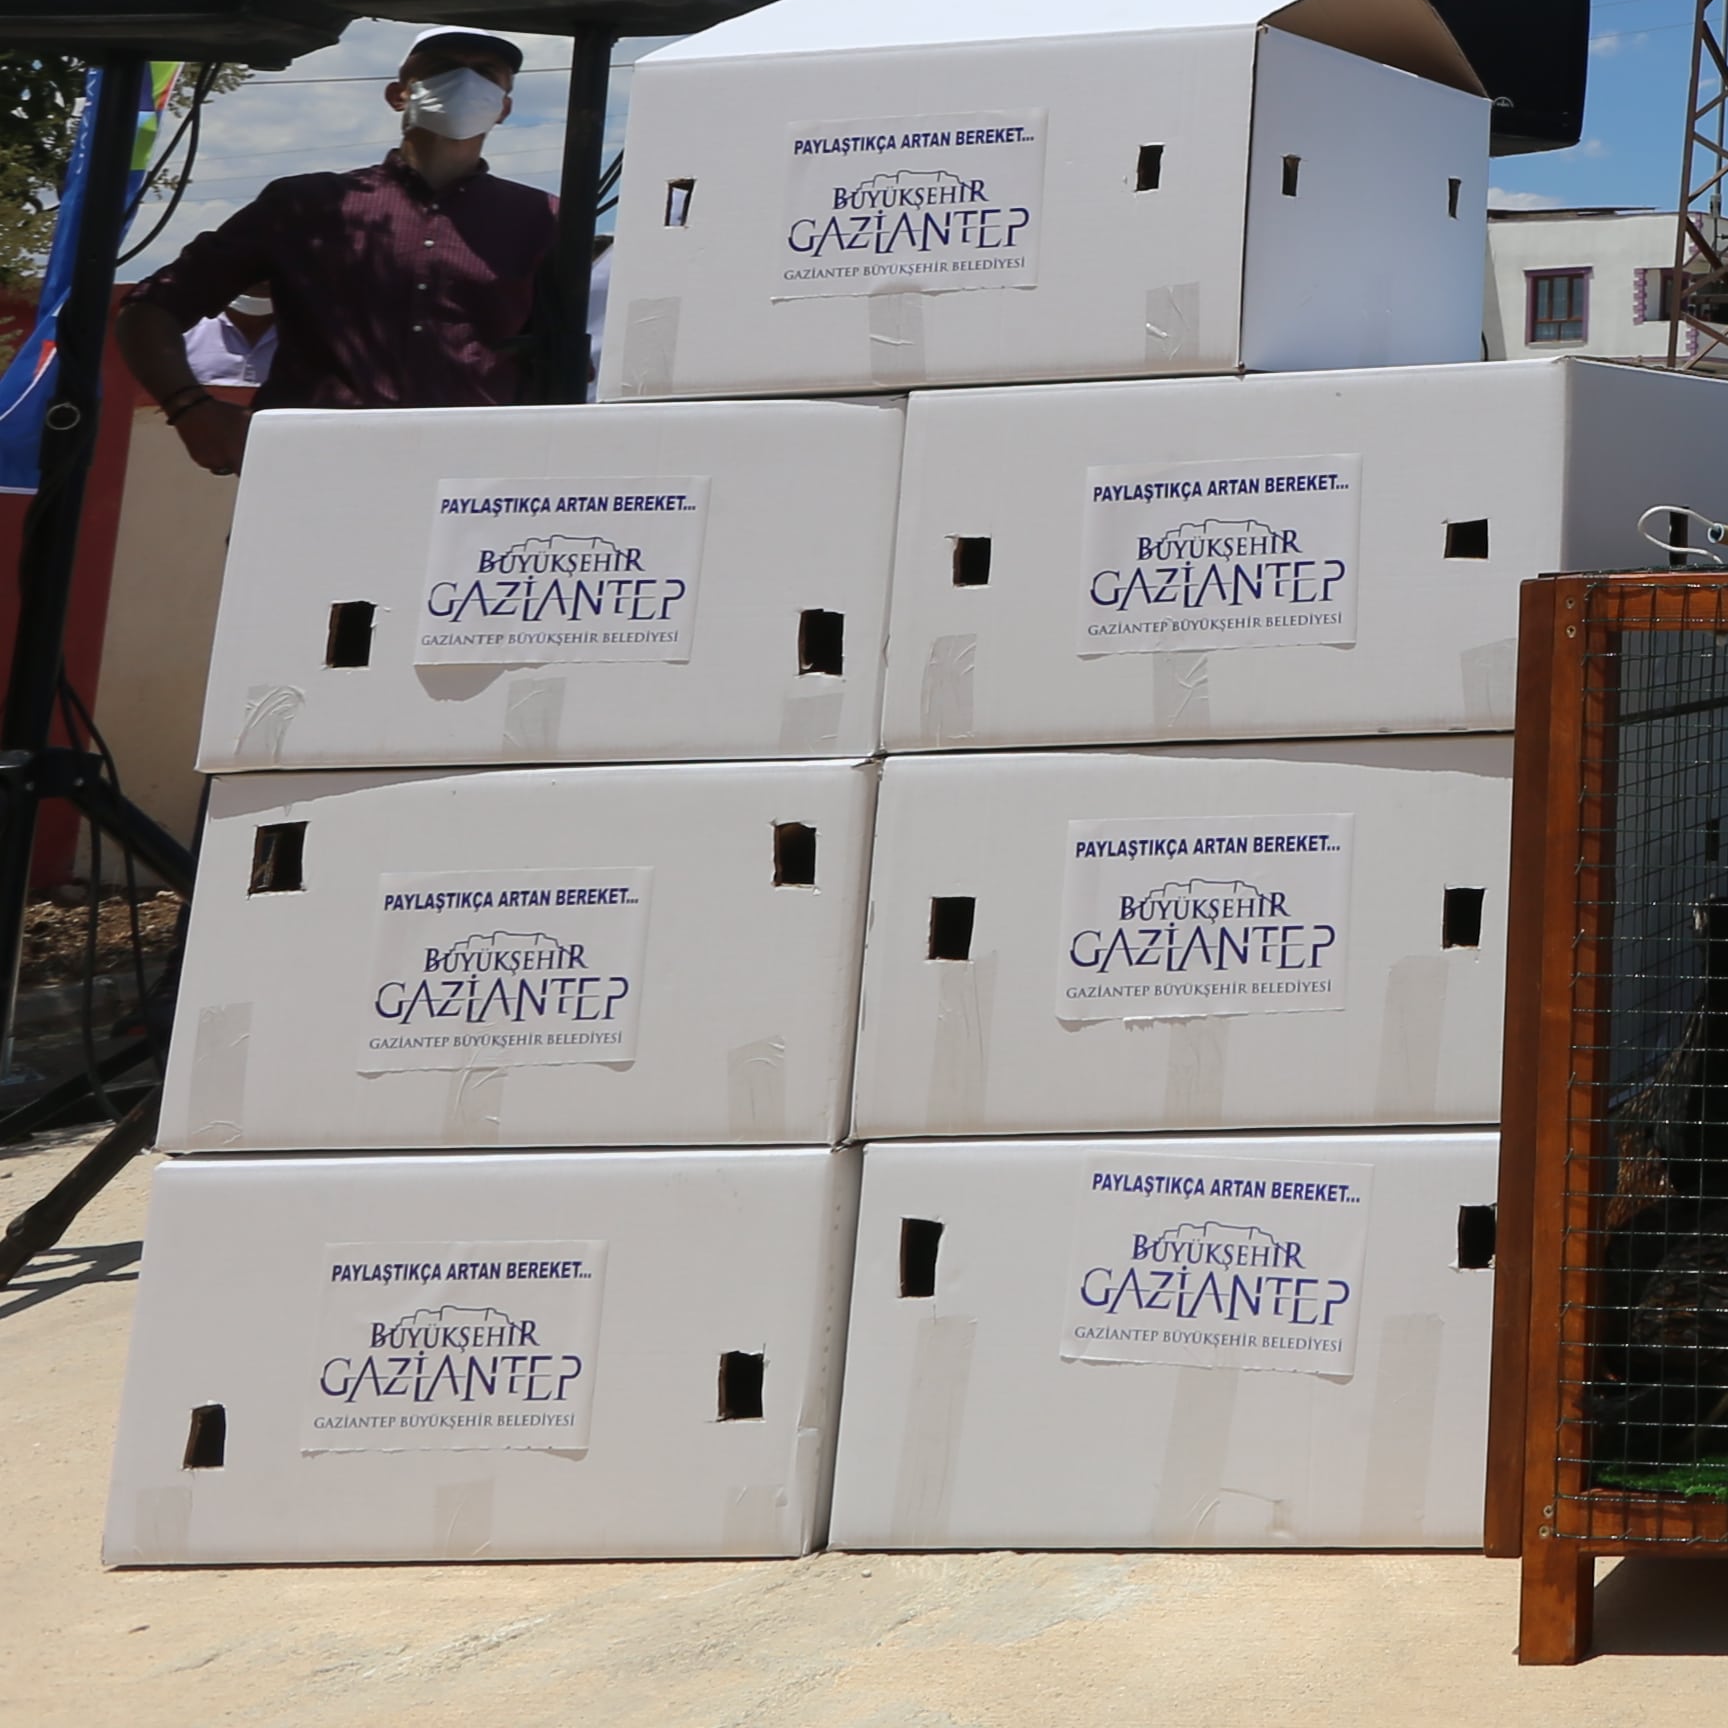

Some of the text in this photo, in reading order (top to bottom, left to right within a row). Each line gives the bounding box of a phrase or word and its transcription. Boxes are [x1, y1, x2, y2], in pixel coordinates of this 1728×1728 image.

[794, 127, 1034, 156] PAYLAŞTIKÇA ARTAN BEREKET...
[832, 178, 989, 210] BÜYÜKŞEHİR
[787, 207, 1030, 257] GAZİANTEP
[784, 255, 1026, 281] GAZİANTEP BÜYÜKŞEHİR BELEDİYESİ
[1093, 474, 1349, 503] PAYLAŞTIKÇA ARTAN BEREKET...
[440, 495, 697, 517] PAYLAŞTIKÇA ARTAN BEREKET...
[1137, 528, 1303, 562] BÜYÜKŞEHİR
[478, 547, 645, 577] BÜYÜKŞEHİR
[428, 575, 686, 623] GAZİANTEP
[1090, 559, 1346, 611] GAZİANTEP
[421, 630, 679, 647] GAZİANTEP BÜYÜKŞEHİR BELEDİYESİ
[1088, 611, 1342, 636] GAZİANTEP BÜYÜKŞEHİR BELEDİYESİ
[1075, 834, 1341, 861] PAYLAŞTIKÇA ARTAN BEREKET...
[384, 888, 639, 913] PAYLAŞTIKÇA ARTAN BEREKET...
[1119, 891, 1291, 925] BÜYÜKŞEHİR
[424, 943, 589, 976] BÜYÜKŞEHİR
[1070, 922, 1336, 974] GAZİANTEP
[375, 974, 629, 1025] GAZİANTEP
[1065, 979, 1332, 999] GAZİANTEP BÜYÜKŞEHİR BELEDİYESİ
[369, 1030, 622, 1050] GAZİANTEP BÜYÜKŞEHİR BELEDİYESİ
[1092, 1173, 1360, 1203] PAYLAŞTIKÇA ARTAN BEREKET...
[1131, 1233, 1307, 1271] BÜYÜKŞEHİR
[331, 1260, 592, 1286] PAYLAŞTIKÇA ARTAN BEREKET...
[1080, 1265, 1350, 1326] GAZİANTEP
[369, 1320, 541, 1354] BÜYÜKŞEHİR
[1074, 1325, 1343, 1353] GAZİANTEP BÜYÜKŞEHİR BELEDİYESİ
[320, 1350, 583, 1403] GAZİANTEP
[313, 1412, 575, 1429] GAZİANTEP BÜYÜKŞEHİR BELEDİYESİ
